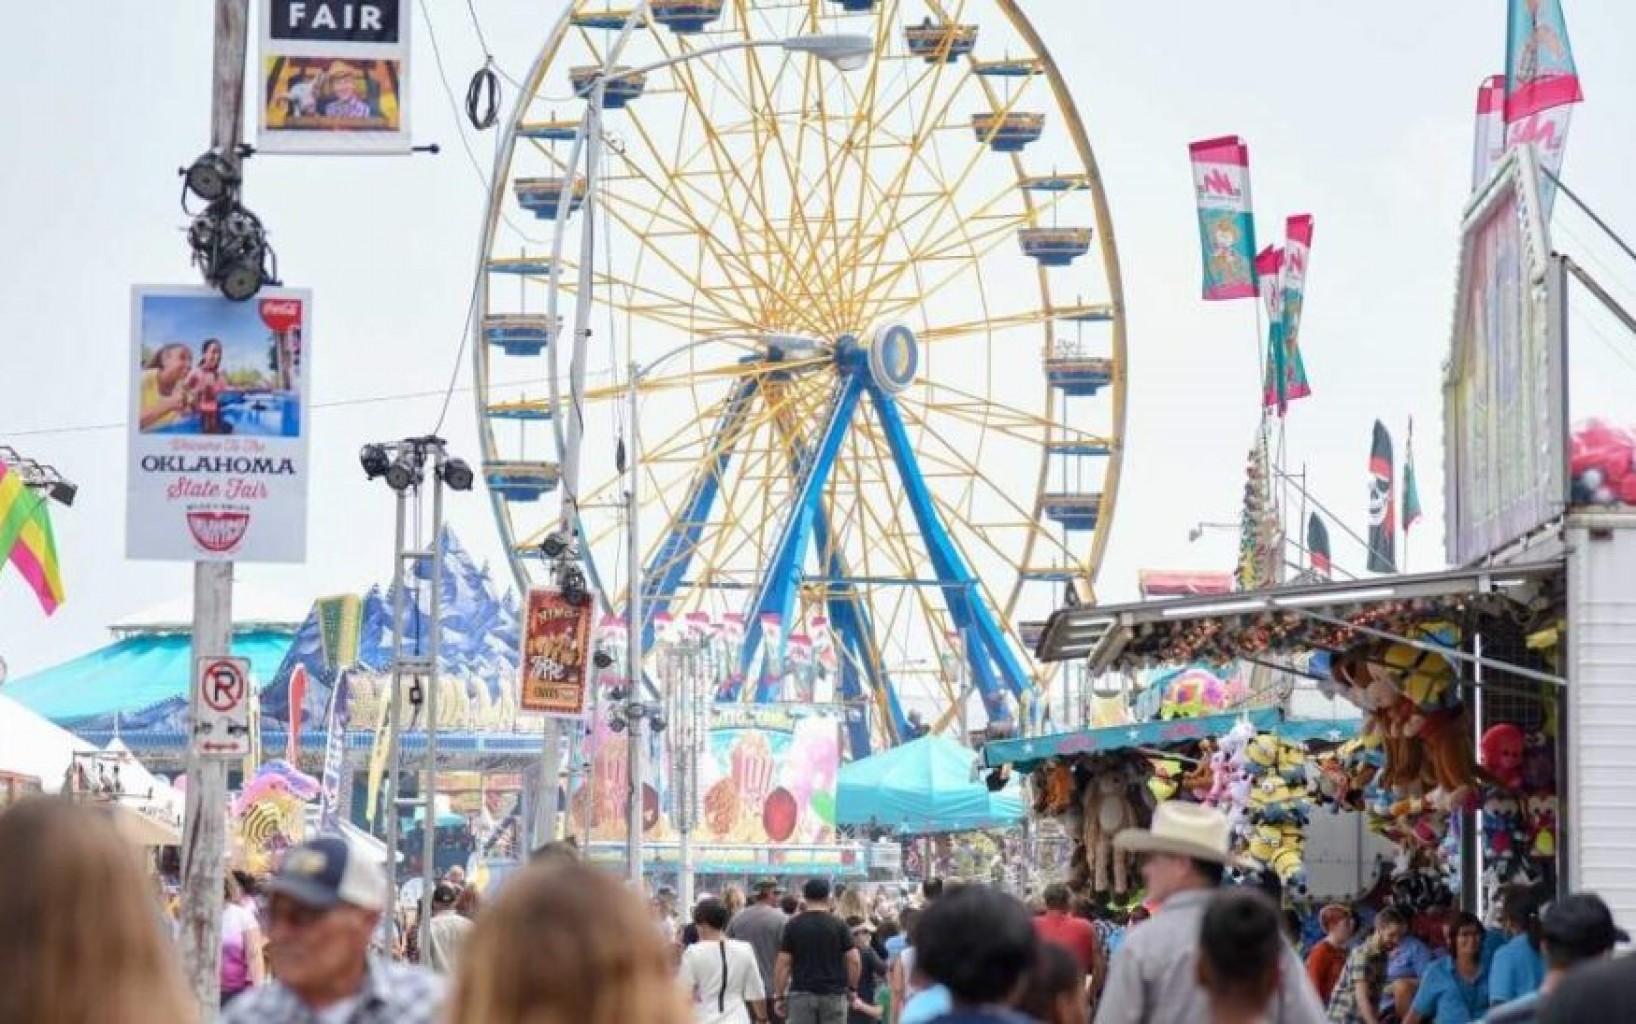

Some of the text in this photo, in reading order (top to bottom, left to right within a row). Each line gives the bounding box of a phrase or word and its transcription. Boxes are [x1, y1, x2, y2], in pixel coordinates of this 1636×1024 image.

[289, 3, 383, 31] FAIR
[141, 454, 296, 476] OKLAHOMA
[167, 475, 268, 500] State Fair
